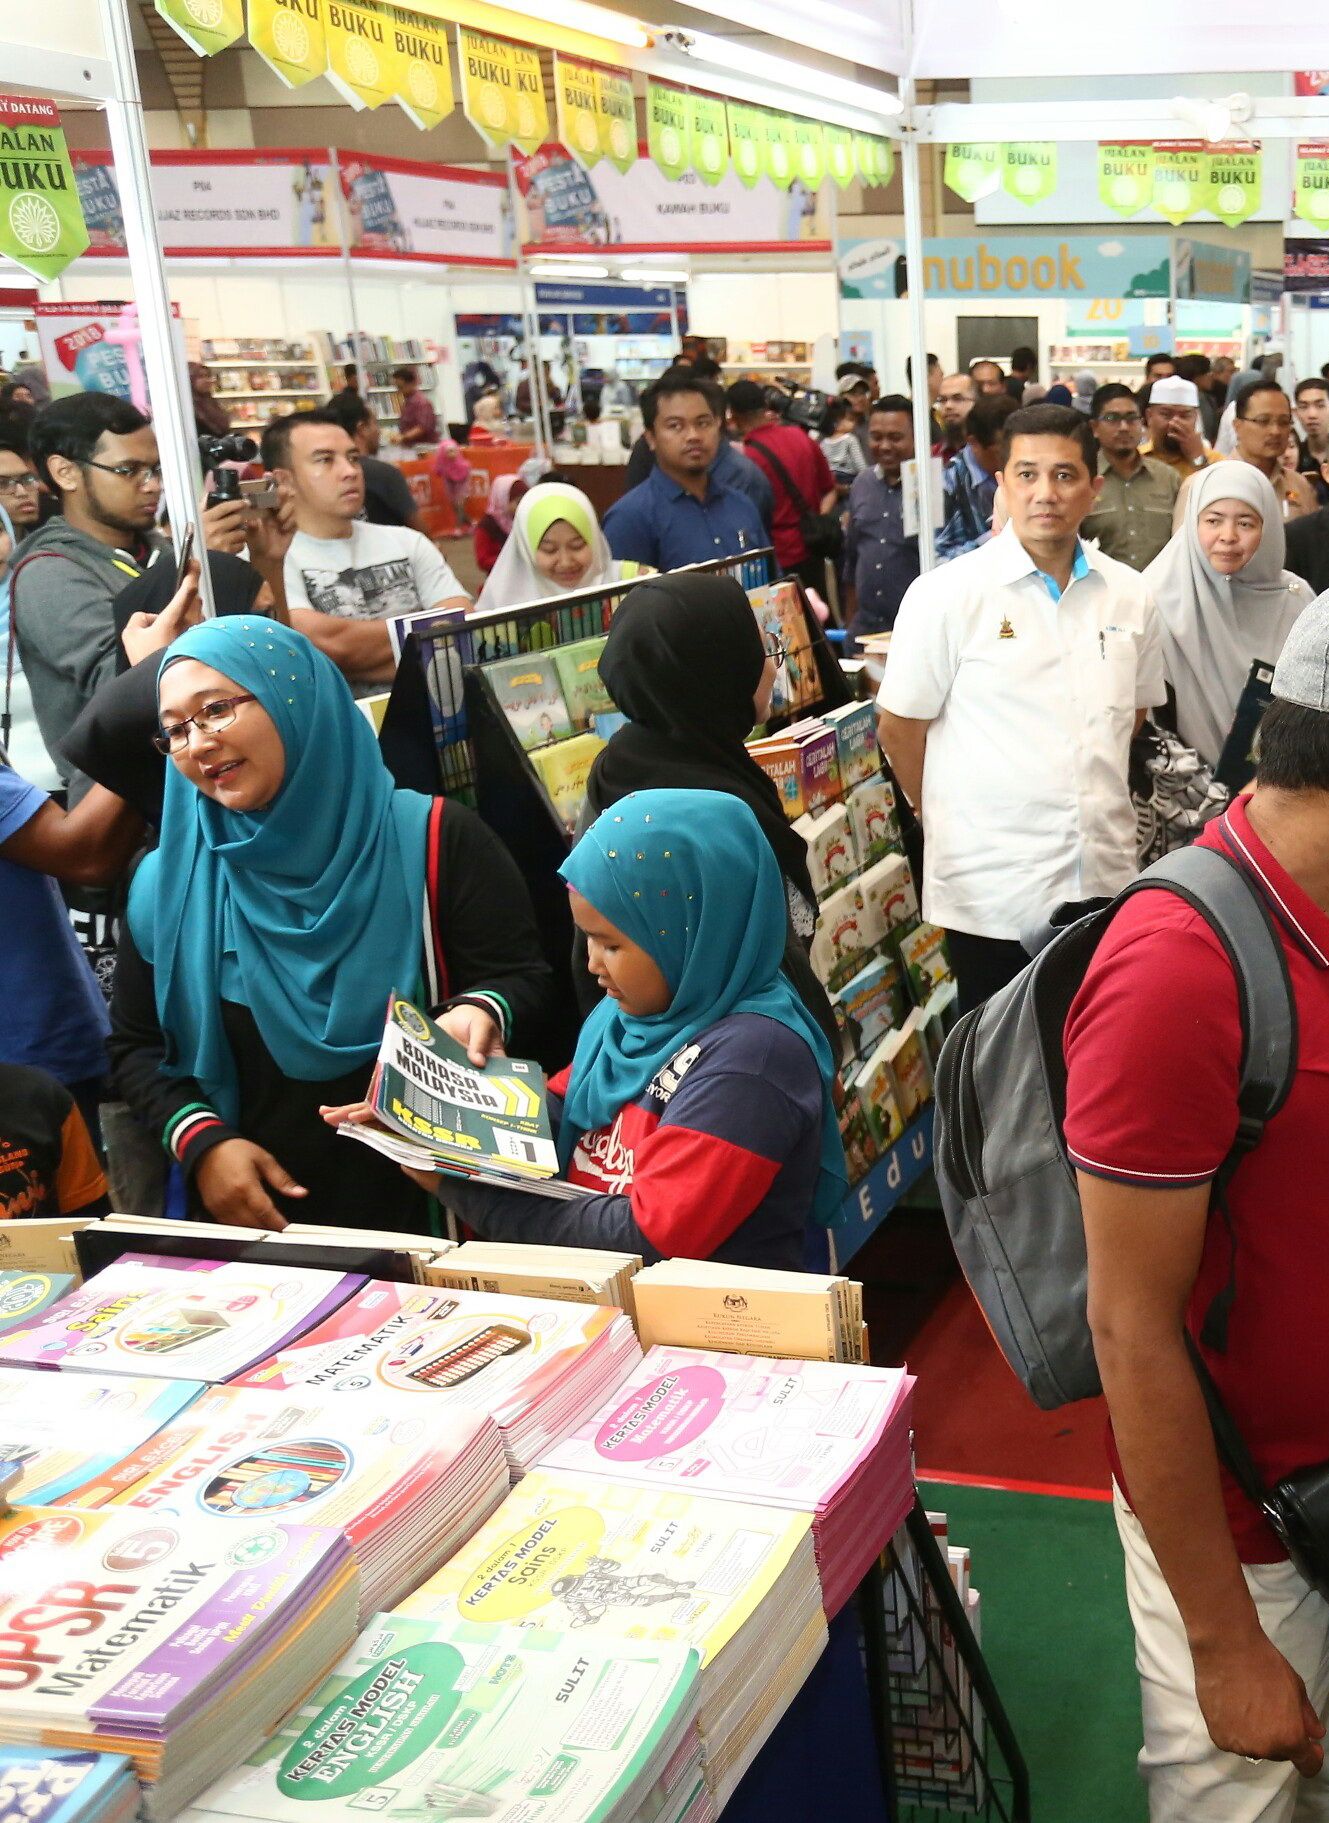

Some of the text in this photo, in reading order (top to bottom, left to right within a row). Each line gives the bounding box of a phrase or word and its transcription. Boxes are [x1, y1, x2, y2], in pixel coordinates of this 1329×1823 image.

[330, 5, 384, 44] BUKU
[395, 31, 443, 66] BUKU
[468, 57, 511, 86] BUKU
[517, 69, 538, 93] KU
[12, 102, 54, 116] DATANG
[952, 145, 996, 163] BUKU
[1007, 151, 1051, 167] BUKU
[1103, 163, 1148, 177] BUKU
[0, 162, 68, 191] UKU
[1155, 169, 1198, 183] BUKU
[1210, 171, 1255, 185] BUKU
[922, 243, 1087, 291] nubook
[396, 1048, 499, 1108] MALAYSIA
[401, 1036, 480, 1092] BAHASA
[392, 1097, 482, 1150] KSSR
[519, 1140, 538, 1164] 1
[305, 1314, 414, 1386] MATEMATIK
[773, 1376, 798, 1406] SULIT
[602, 1375, 680, 1450] KERTAS MODEL
[127, 1413, 268, 1509] ENGLISH
[650, 1520, 681, 1554] SULIT
[465, 1518, 558, 1607] KERTAS MODEL
[507, 1544, 557, 1587] Sains
[0, 1580, 142, 1691] UPSR
[33, 1561, 217, 1697] Matematik
[554, 1657, 591, 1704] SULIT
[285, 1718, 358, 1783] KERTAS
[349, 1657, 408, 1720] MODEL
[311, 1669, 426, 1784] ENGLISH
[314, 1704, 348, 1741] dalam
[366, 1793, 390, 1806] 5
